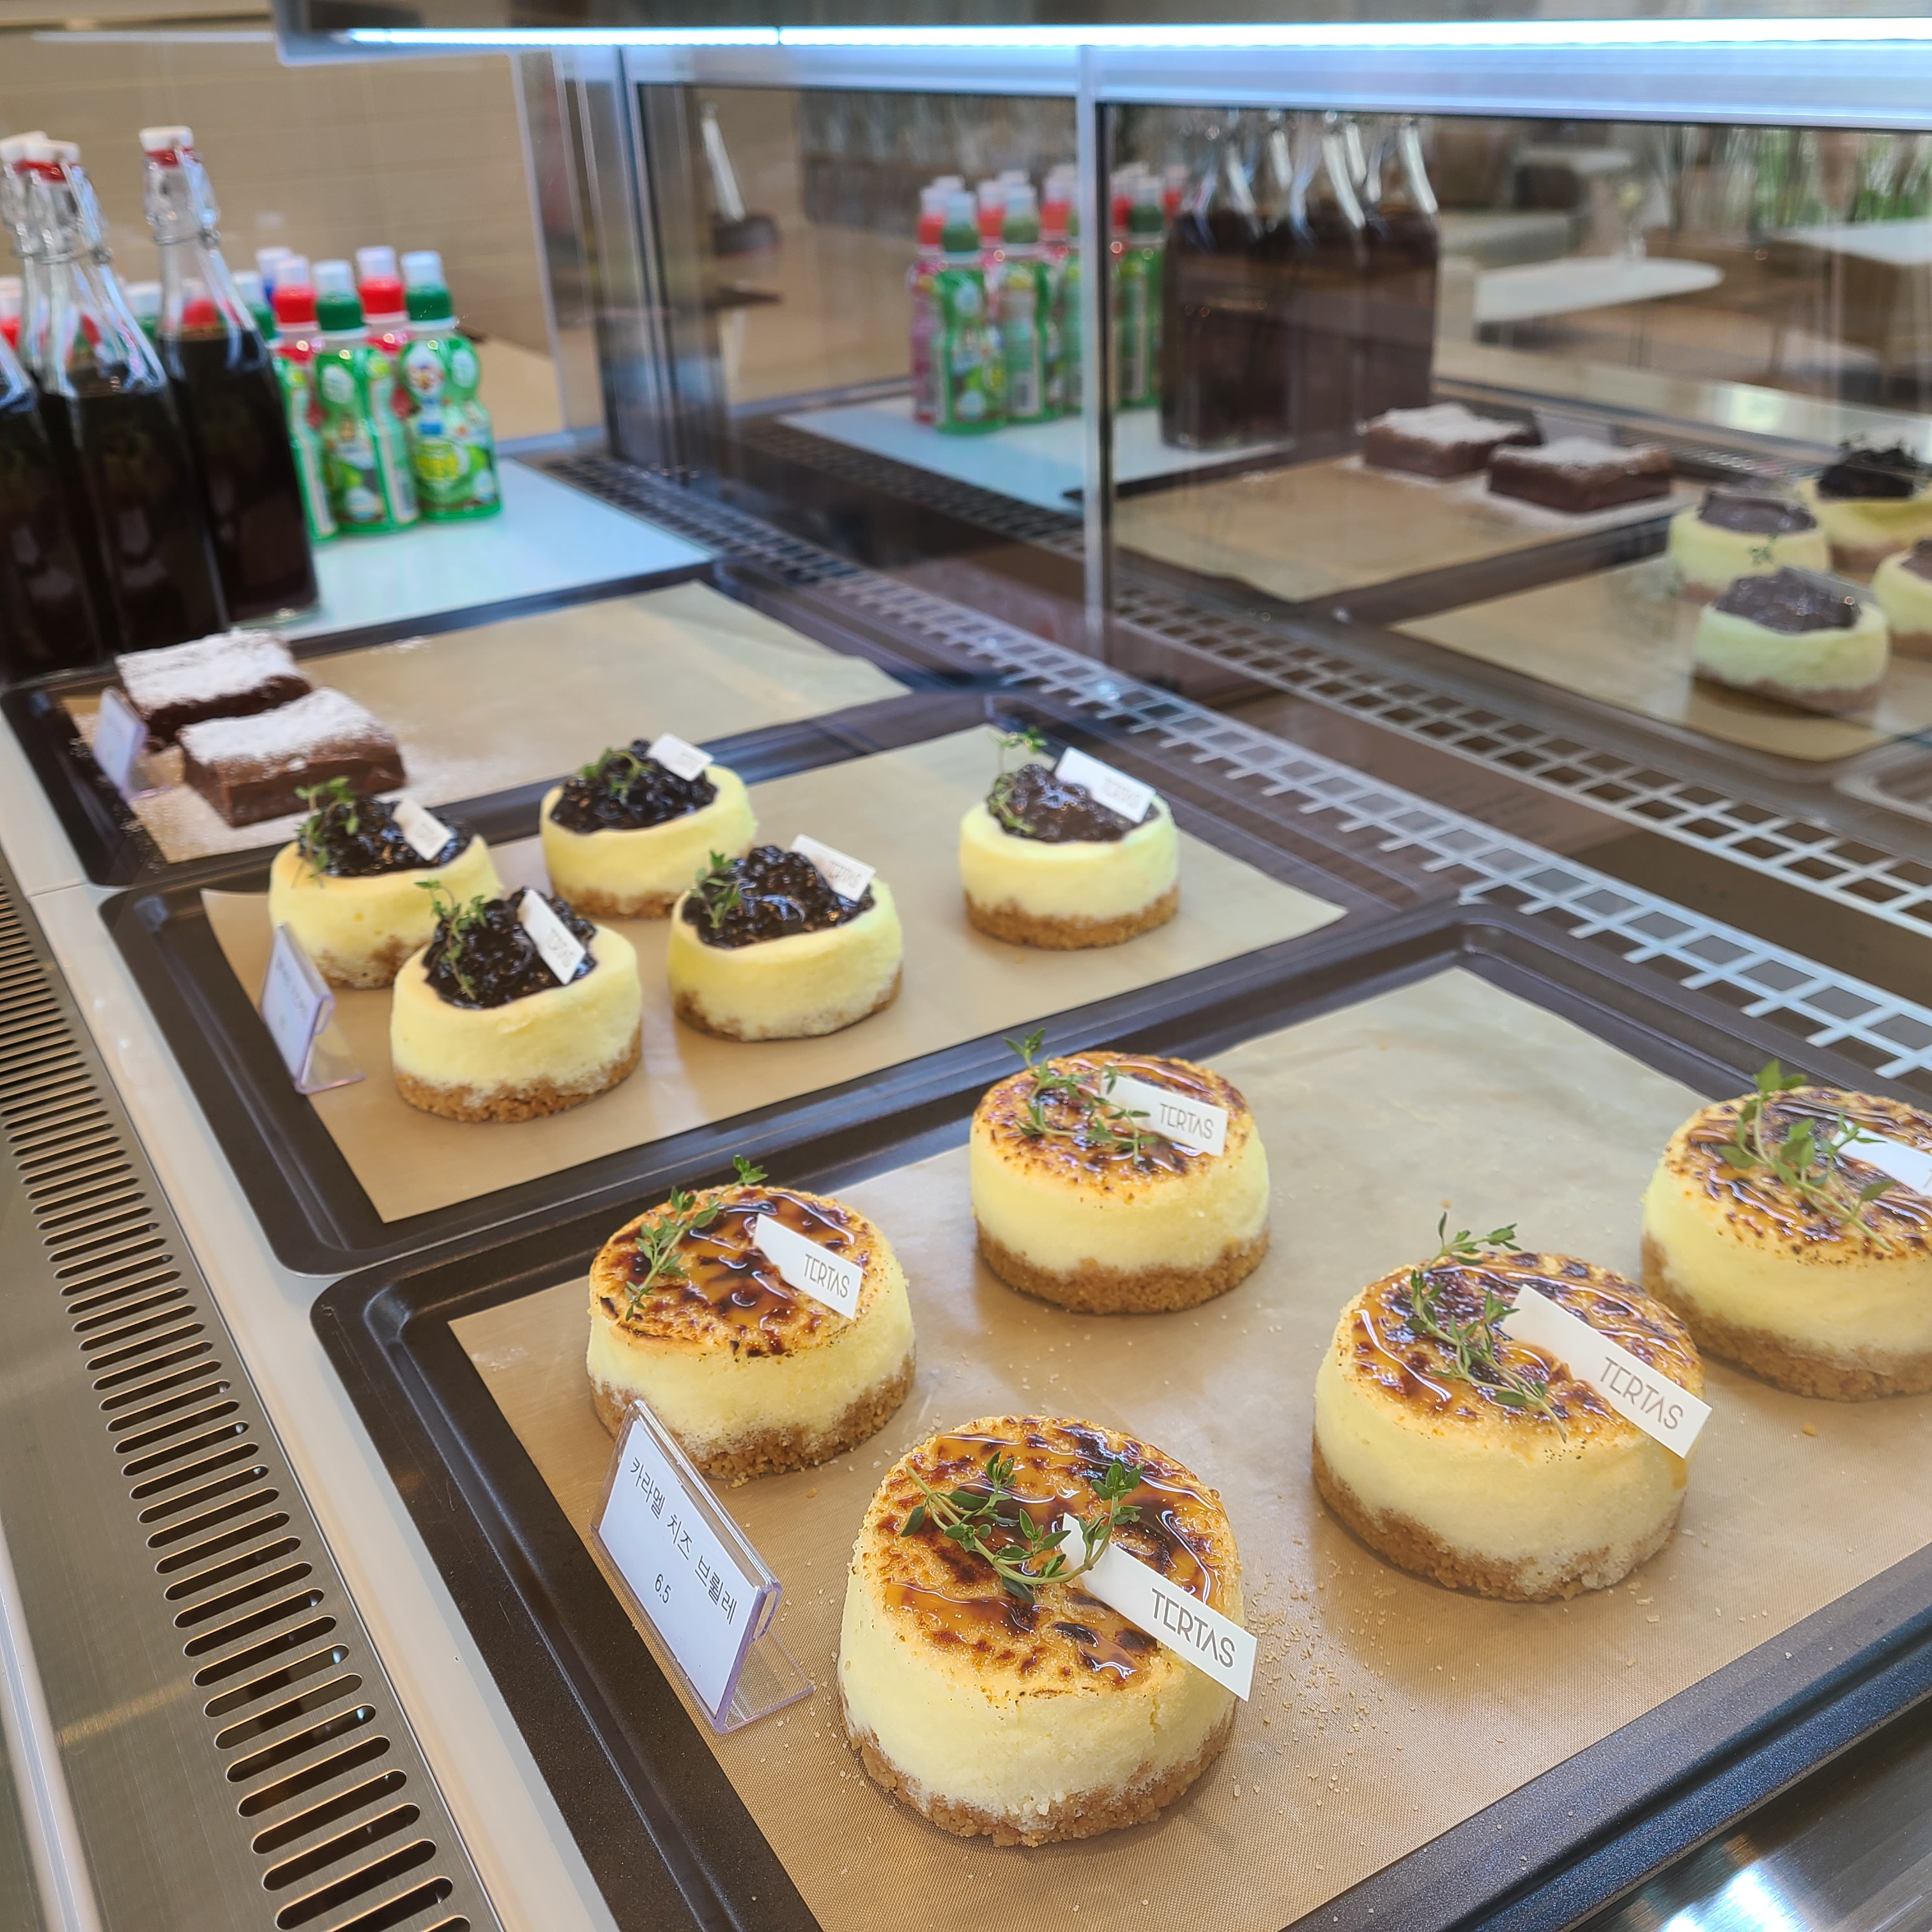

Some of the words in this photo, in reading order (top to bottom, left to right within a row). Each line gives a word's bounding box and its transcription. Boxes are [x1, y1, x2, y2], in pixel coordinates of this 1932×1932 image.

[1160, 1103, 1214, 1139] TERTAS
[804, 1254, 850, 1298] TERTAS
[1600, 1356, 1683, 1430] TERTAS
[630, 1457, 665, 1519] 카라멜
[667, 1514, 692, 1560] 치즈
[695, 1555, 737, 1625] 브륄레
[655, 1574, 671, 1603] 6.5
[1151, 1587, 1236, 1668] TERTAS
